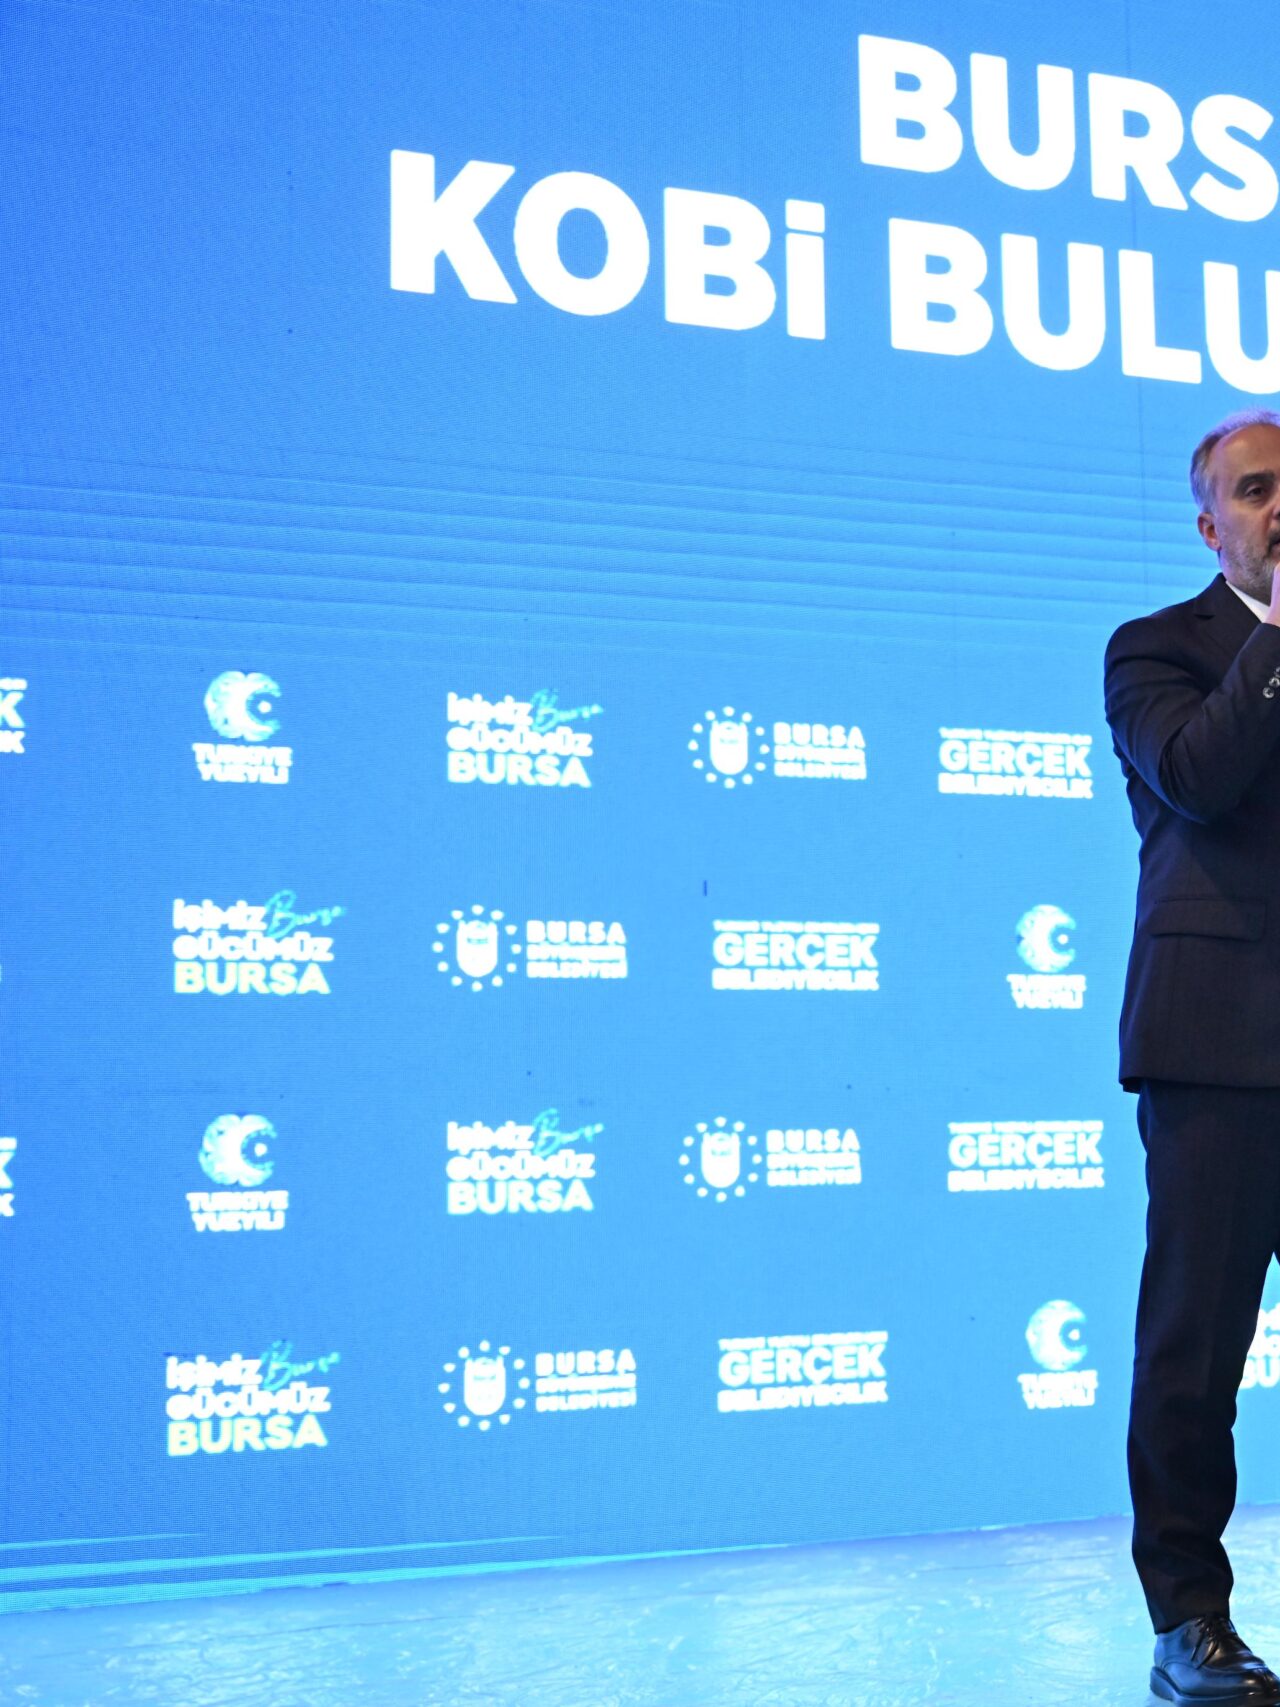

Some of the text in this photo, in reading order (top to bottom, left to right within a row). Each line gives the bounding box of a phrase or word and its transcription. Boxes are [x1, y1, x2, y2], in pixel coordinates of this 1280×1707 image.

[774, 722, 866, 747] BURSA
[447, 751, 592, 788] BURSA
[939, 740, 1092, 776] GERÇEK
[526, 920, 627, 945] BURSA
[713, 932, 879, 969] GERÇEK
[174, 961, 331, 995] BURSA
[767, 1128, 860, 1152] BURSA
[949, 1132, 1103, 1168] GERÇEK
[447, 1179, 593, 1214] BURSA
[536, 1349, 636, 1376] BURSA
[718, 1344, 886, 1386] GERÇEK
[168, 1413, 329, 1457] BURSA
